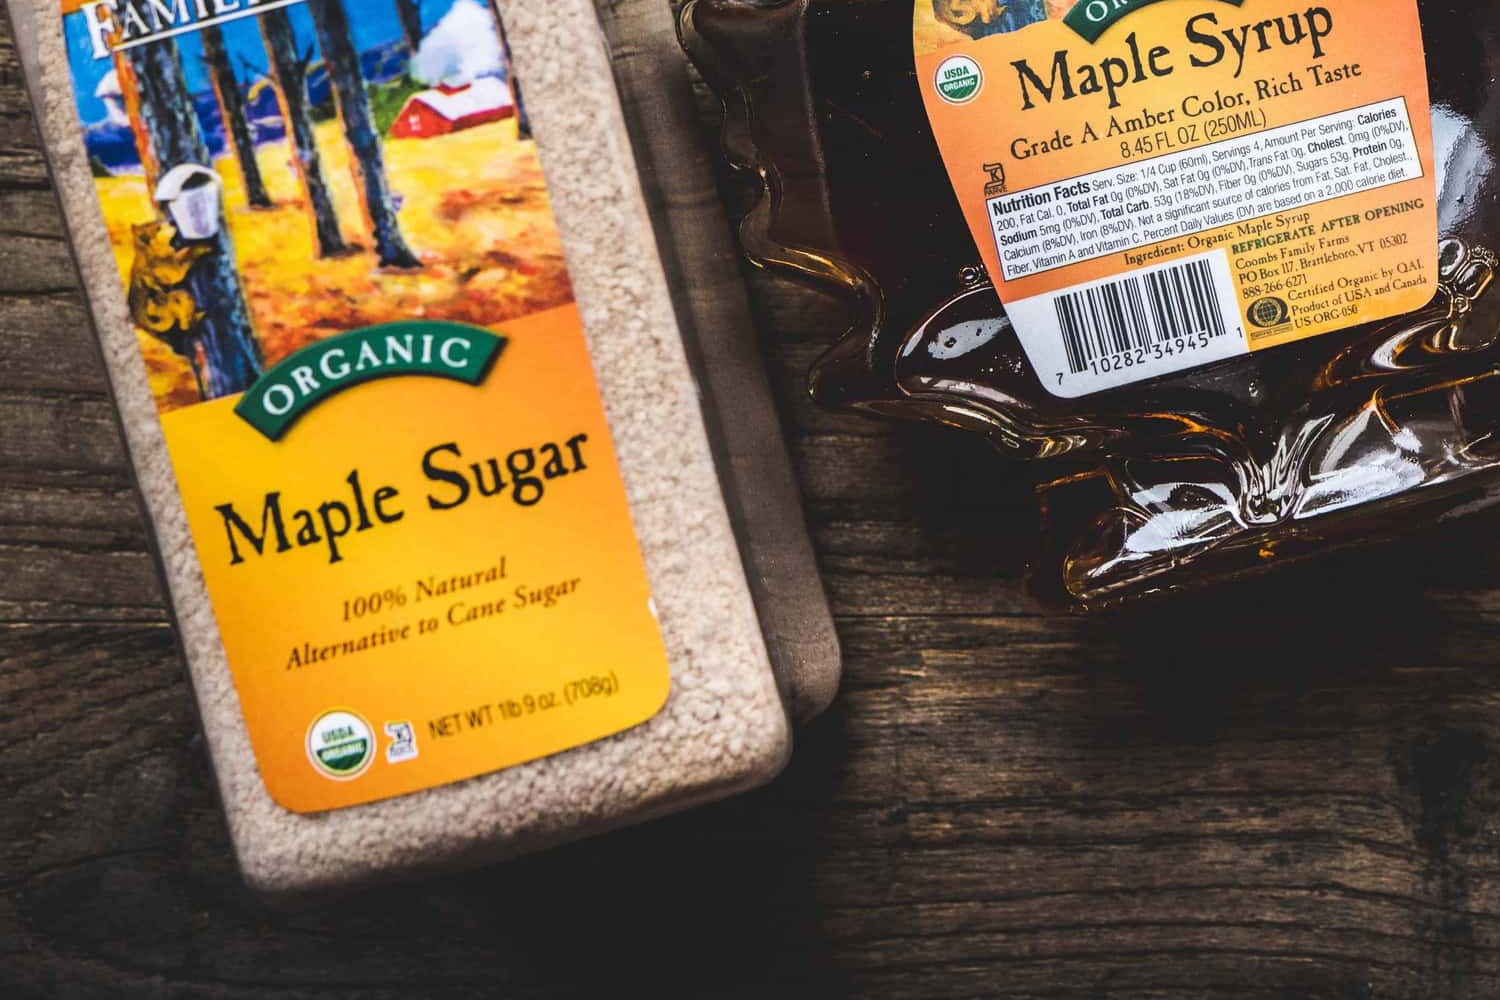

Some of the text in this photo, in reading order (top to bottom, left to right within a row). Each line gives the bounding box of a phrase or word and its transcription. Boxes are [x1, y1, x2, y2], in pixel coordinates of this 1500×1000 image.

[943, 64, 970, 80] USDA
[1009, 2, 1333, 111] Maple Syrup
[1009, 63, 1362, 160] Grade A Amber Color, Rich Taste
[1119, 107, 1267, 159] 8.45 FL OZ (250ML)
[991, 191, 1052, 216] Nutrition
[1052, 180, 1091, 201] Facts
[1091, 178, 1115, 191] Serv.
[1115, 172, 1137, 185] Size:
[1140, 165, 1156, 179] 1/4
[1157, 162, 1177, 176] Cup
[1211, 144, 1251, 162] Servings
[1264, 131, 1300, 149] Amount
[1299, 127, 1316, 140] Per
[1317, 119, 1355, 135] Serving:
[1356, 108, 1397, 125] Calories
[1123, 212, 1310, 265] Ingredient: Organic Maple Syrup
[1230, 197, 1424, 255] REFRIGERATE AFTER OPENING
[1234, 235, 1350, 270] Coombs Family Farms
[1237, 270, 1258, 285] PO
[1258, 267, 1280, 280] Box
[1356, 239, 1374, 254] VT
[1378, 232, 1408, 249] 05302
[1241, 272, 1307, 299] 888-266-6271
[262, 332, 473, 417] ORGANIC
[1055, 371, 1063, 385] 7
[1088, 348, 1146, 375] 10282
[1151, 332, 1208, 359] 34945
[212, 432, 588, 566] Maple Sugar
[342, 554, 506, 622] 100% Natural
[284, 577, 581, 671] Alternative to Cane Sugar
[427, 712, 461, 738] NET
[465, 704, 492, 728] WT
[522, 694, 536, 714] 9
